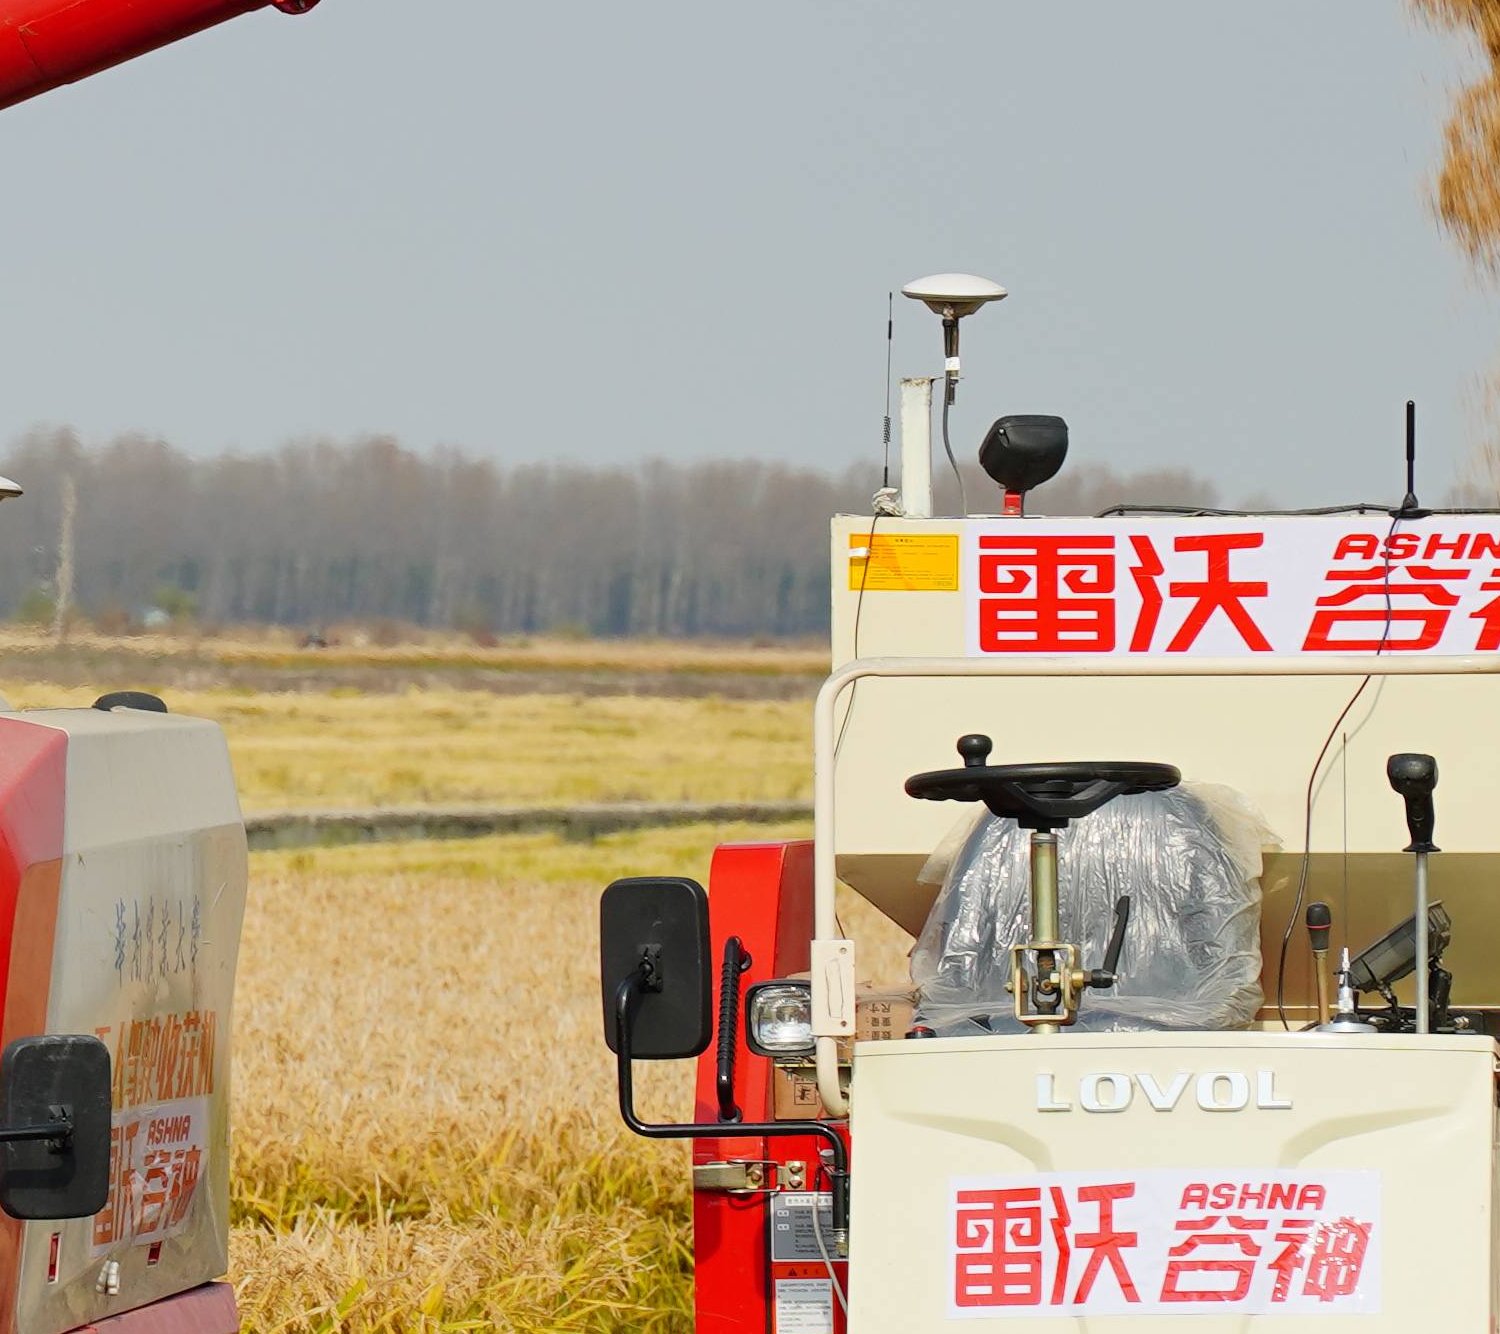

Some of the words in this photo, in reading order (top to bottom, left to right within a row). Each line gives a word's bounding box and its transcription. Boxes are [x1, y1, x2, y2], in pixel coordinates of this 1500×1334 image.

[1036, 1071, 1294, 1113] LOVOL
[147, 1115, 191, 1145] ASHNA
[1179, 1183, 1327, 1211] ASHNA
[954, 1182, 1373, 1308] 雷沃谷神
